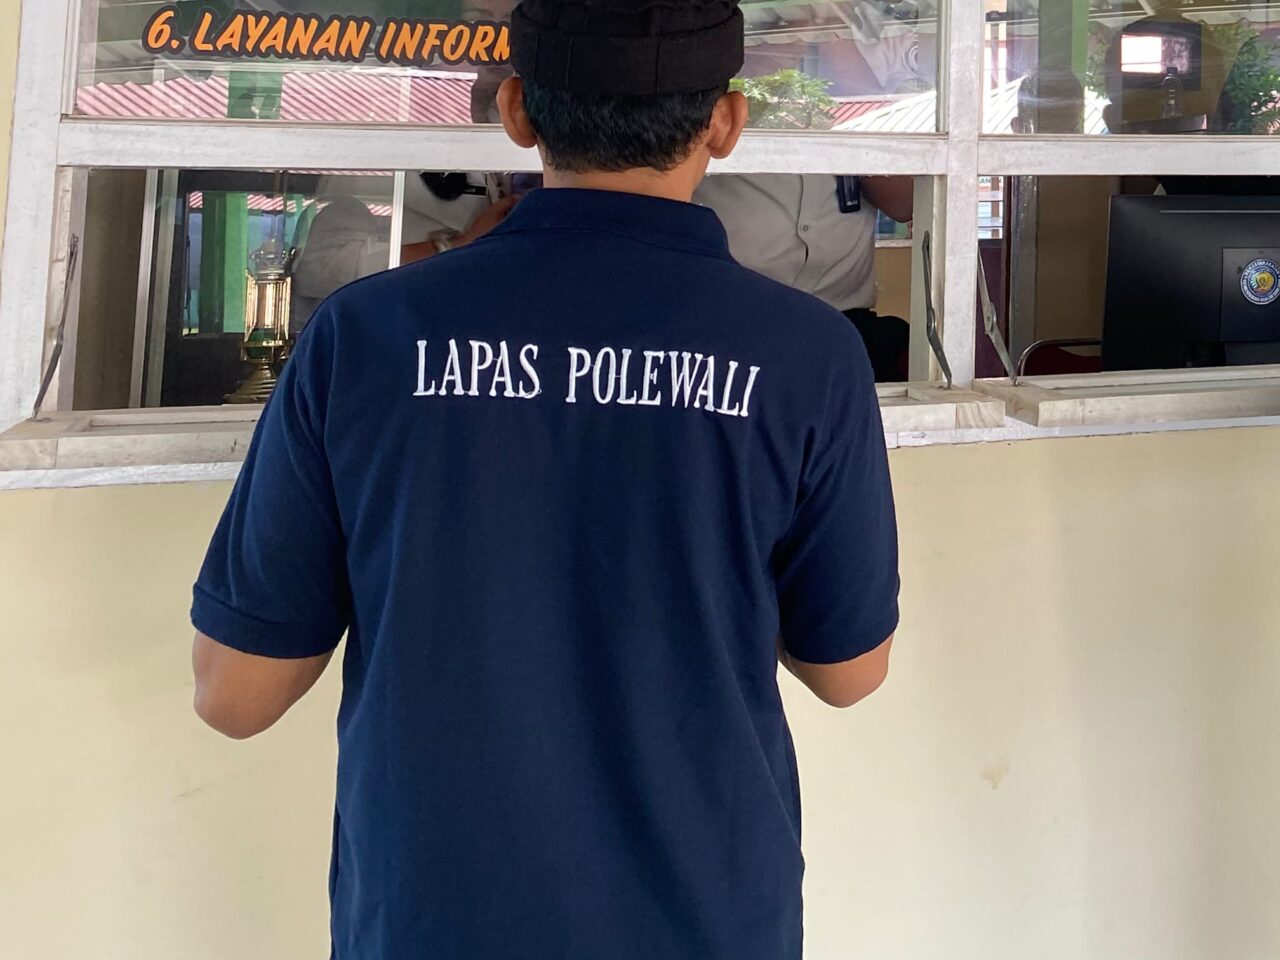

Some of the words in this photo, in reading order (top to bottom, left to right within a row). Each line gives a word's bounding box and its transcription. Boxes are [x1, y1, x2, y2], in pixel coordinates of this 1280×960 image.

[147, 10, 180, 49] 6.
[194, 12, 369, 56] LAYANAN
[412, 338, 542, 400] LAPAS
[564, 345, 761, 418] POLEWALI
